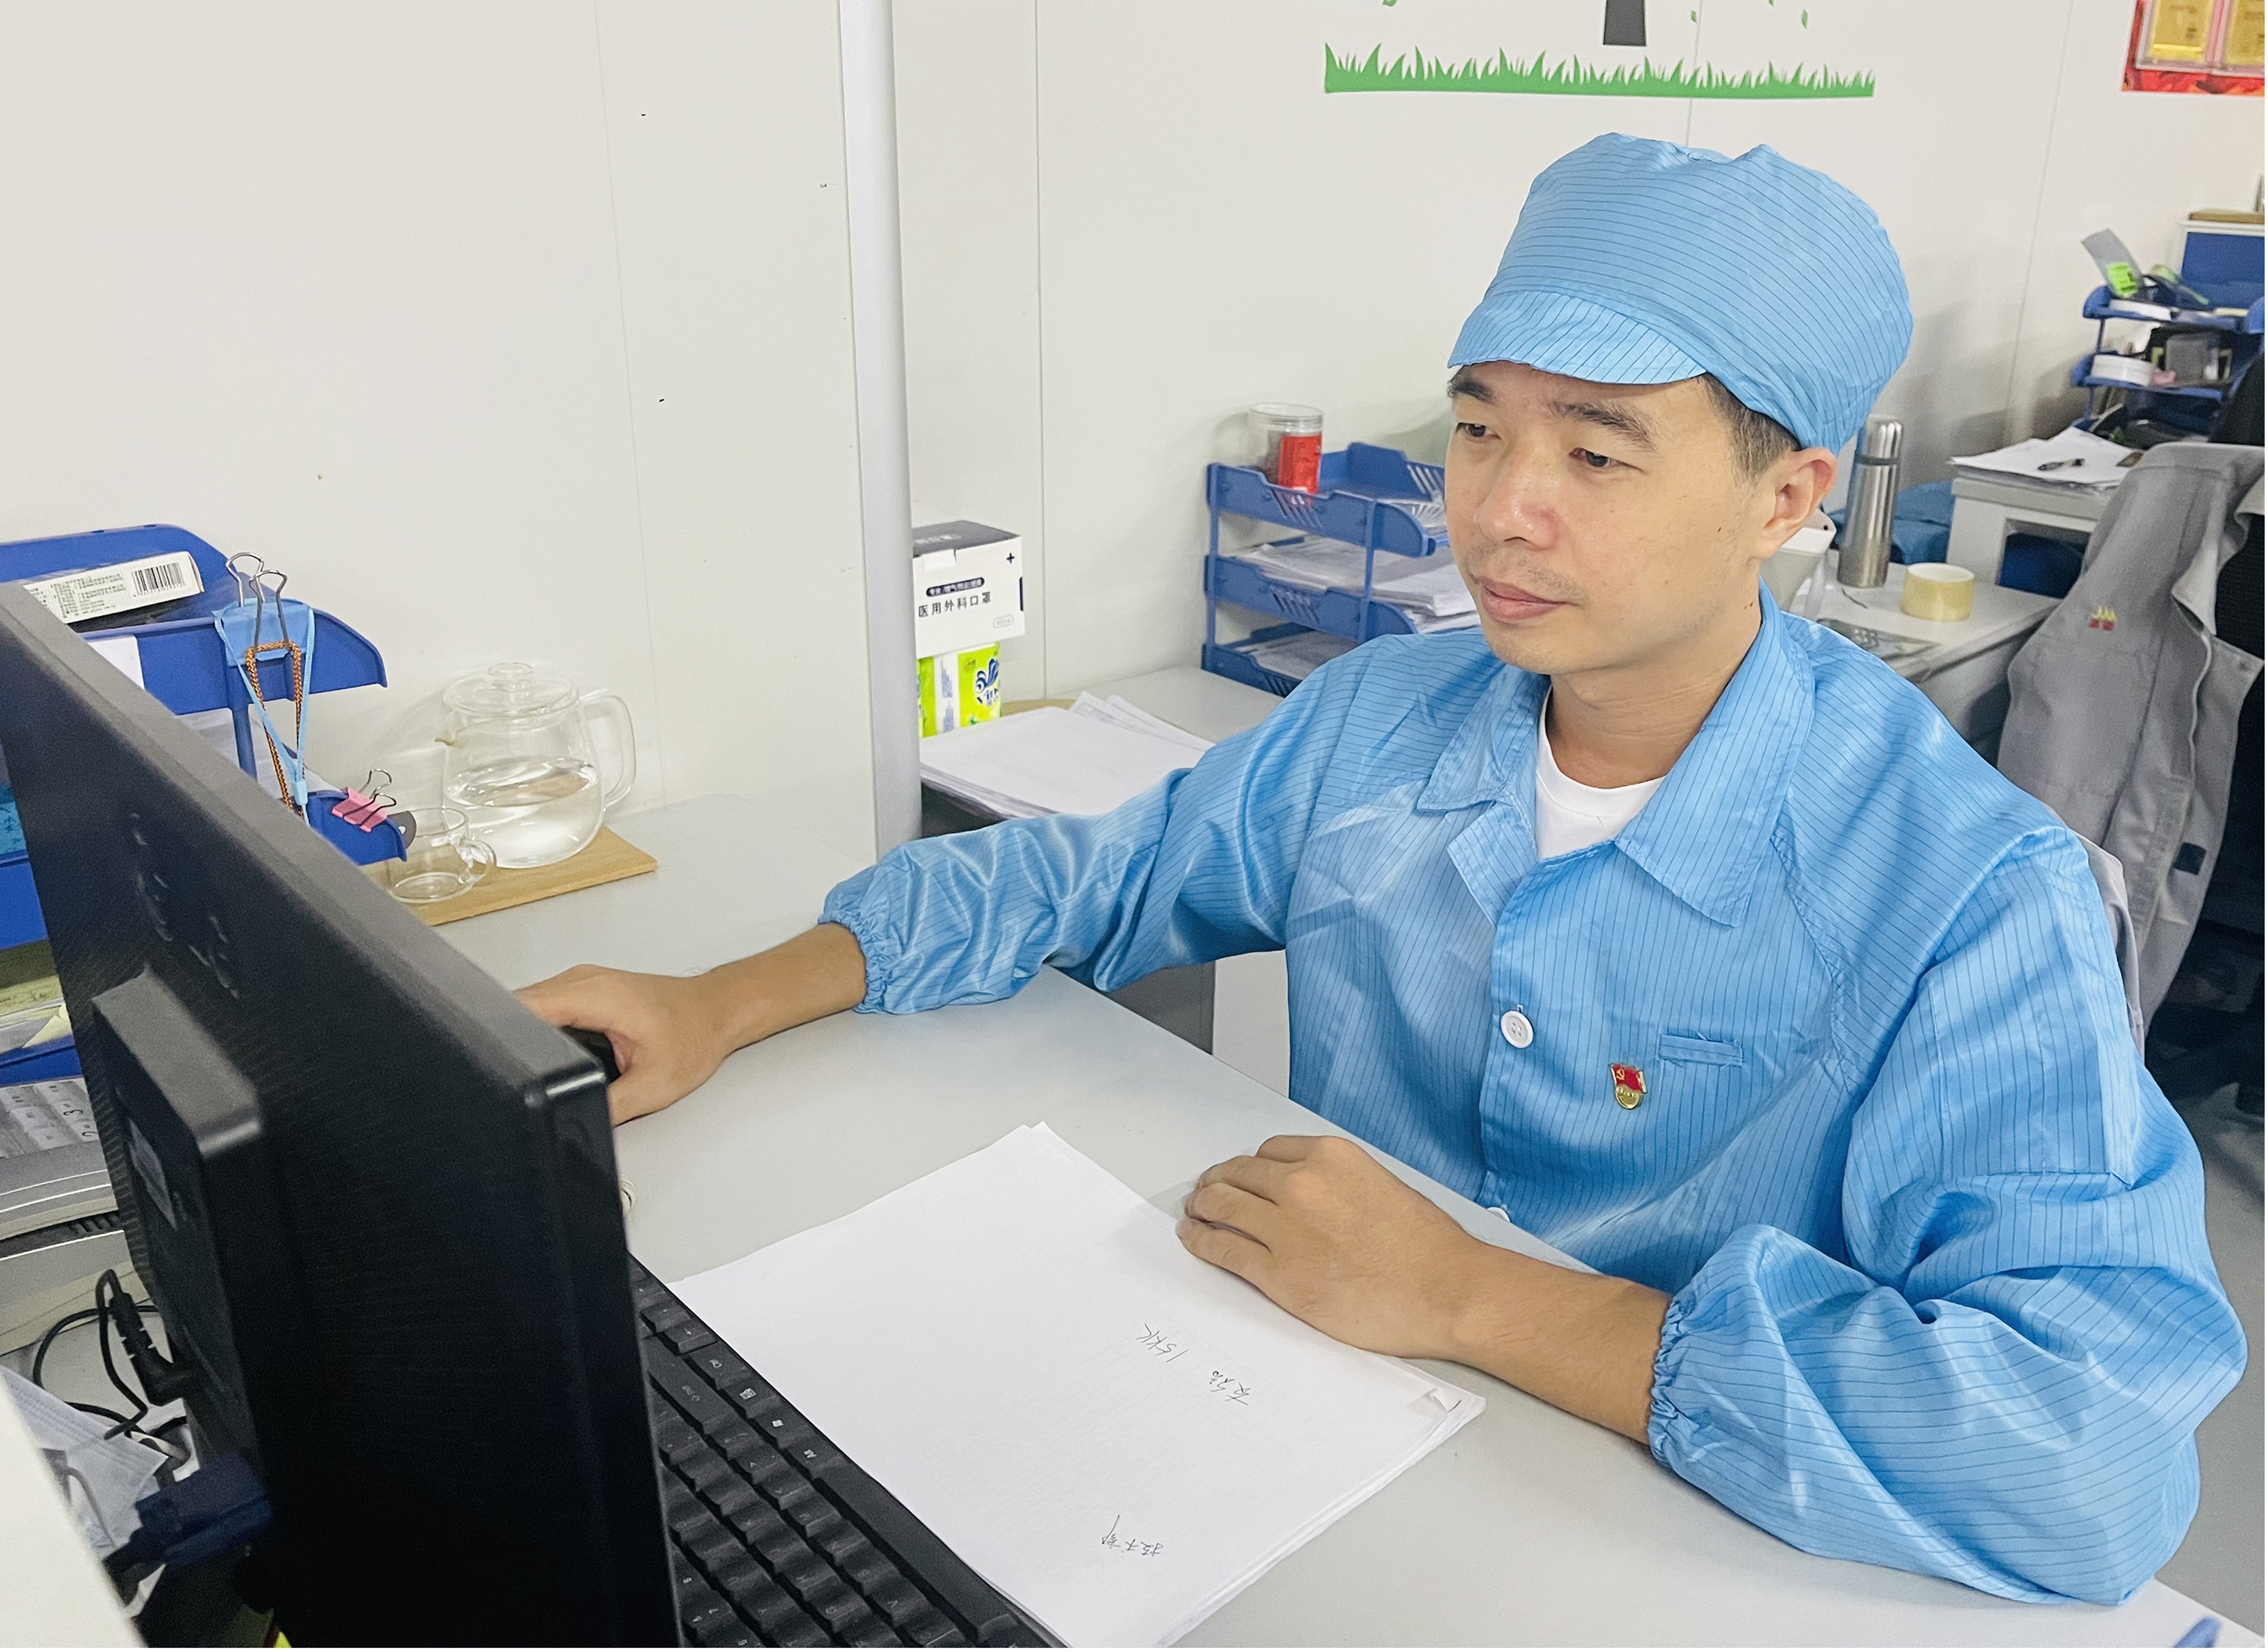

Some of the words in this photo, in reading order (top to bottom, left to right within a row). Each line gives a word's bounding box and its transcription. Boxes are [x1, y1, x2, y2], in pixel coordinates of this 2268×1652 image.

[918, 591, 991, 618] 医用外科口罩
